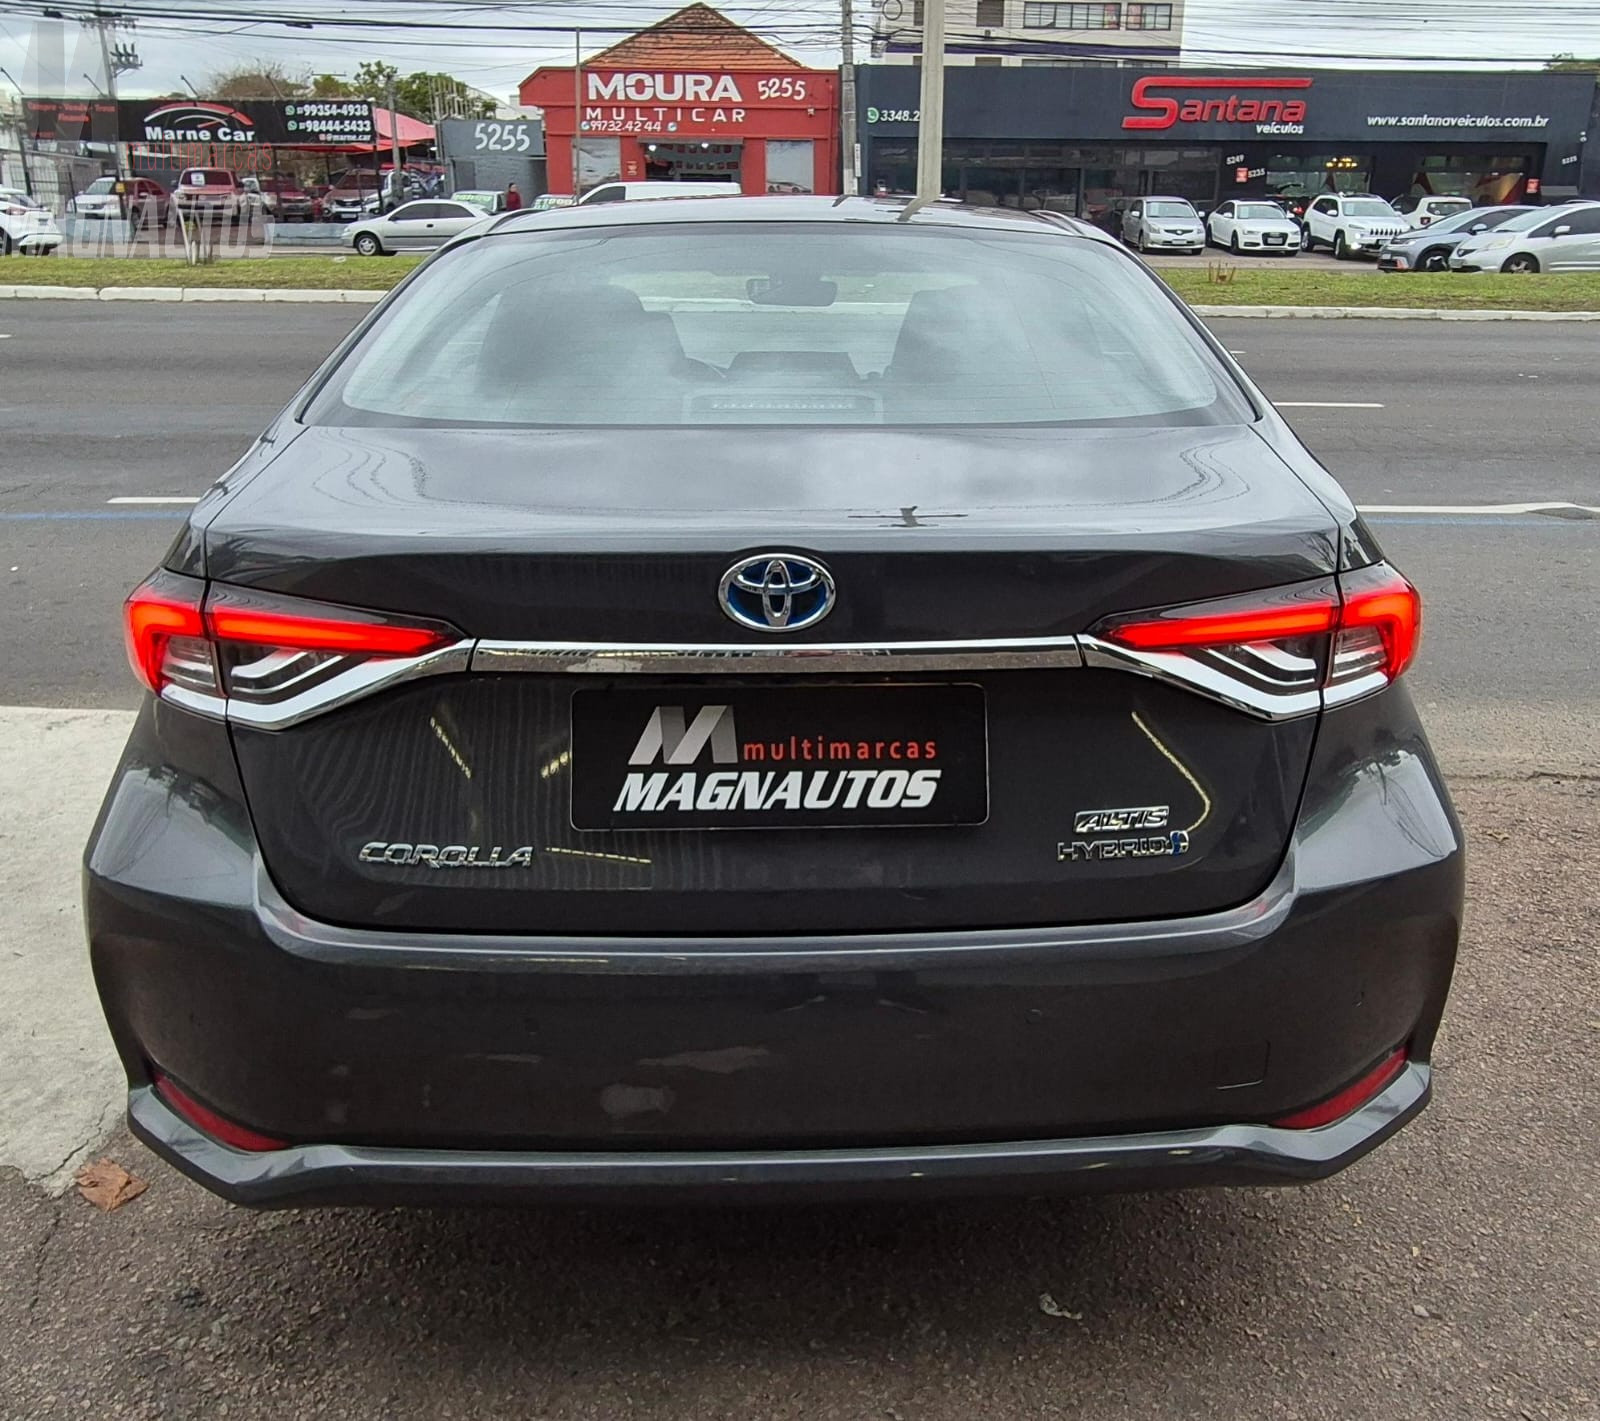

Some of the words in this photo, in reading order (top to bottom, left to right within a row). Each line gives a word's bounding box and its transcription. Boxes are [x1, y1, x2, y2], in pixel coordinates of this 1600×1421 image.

[587, 73, 742, 102] MOURA
[757, 78, 806, 101] 5255
[586, 108, 746, 122] MULTICAR
[1121, 76, 1313, 129] Santana
[880, 110, 920, 121] 3348.2
[1367, 114, 1549, 127] www.santanaveiculos.com.br
[145, 127, 211, 140] Marne
[217, 127, 255, 141] Car
[475, 123, 530, 151] 5255
[743, 736, 938, 761] multimarcas
[613, 770, 941, 811] MAGNAUTOS
[1074, 806, 1169, 833] ALTIS
[359, 842, 533, 868] COROLLA
[1057, 836, 1171, 861] HYBRID
